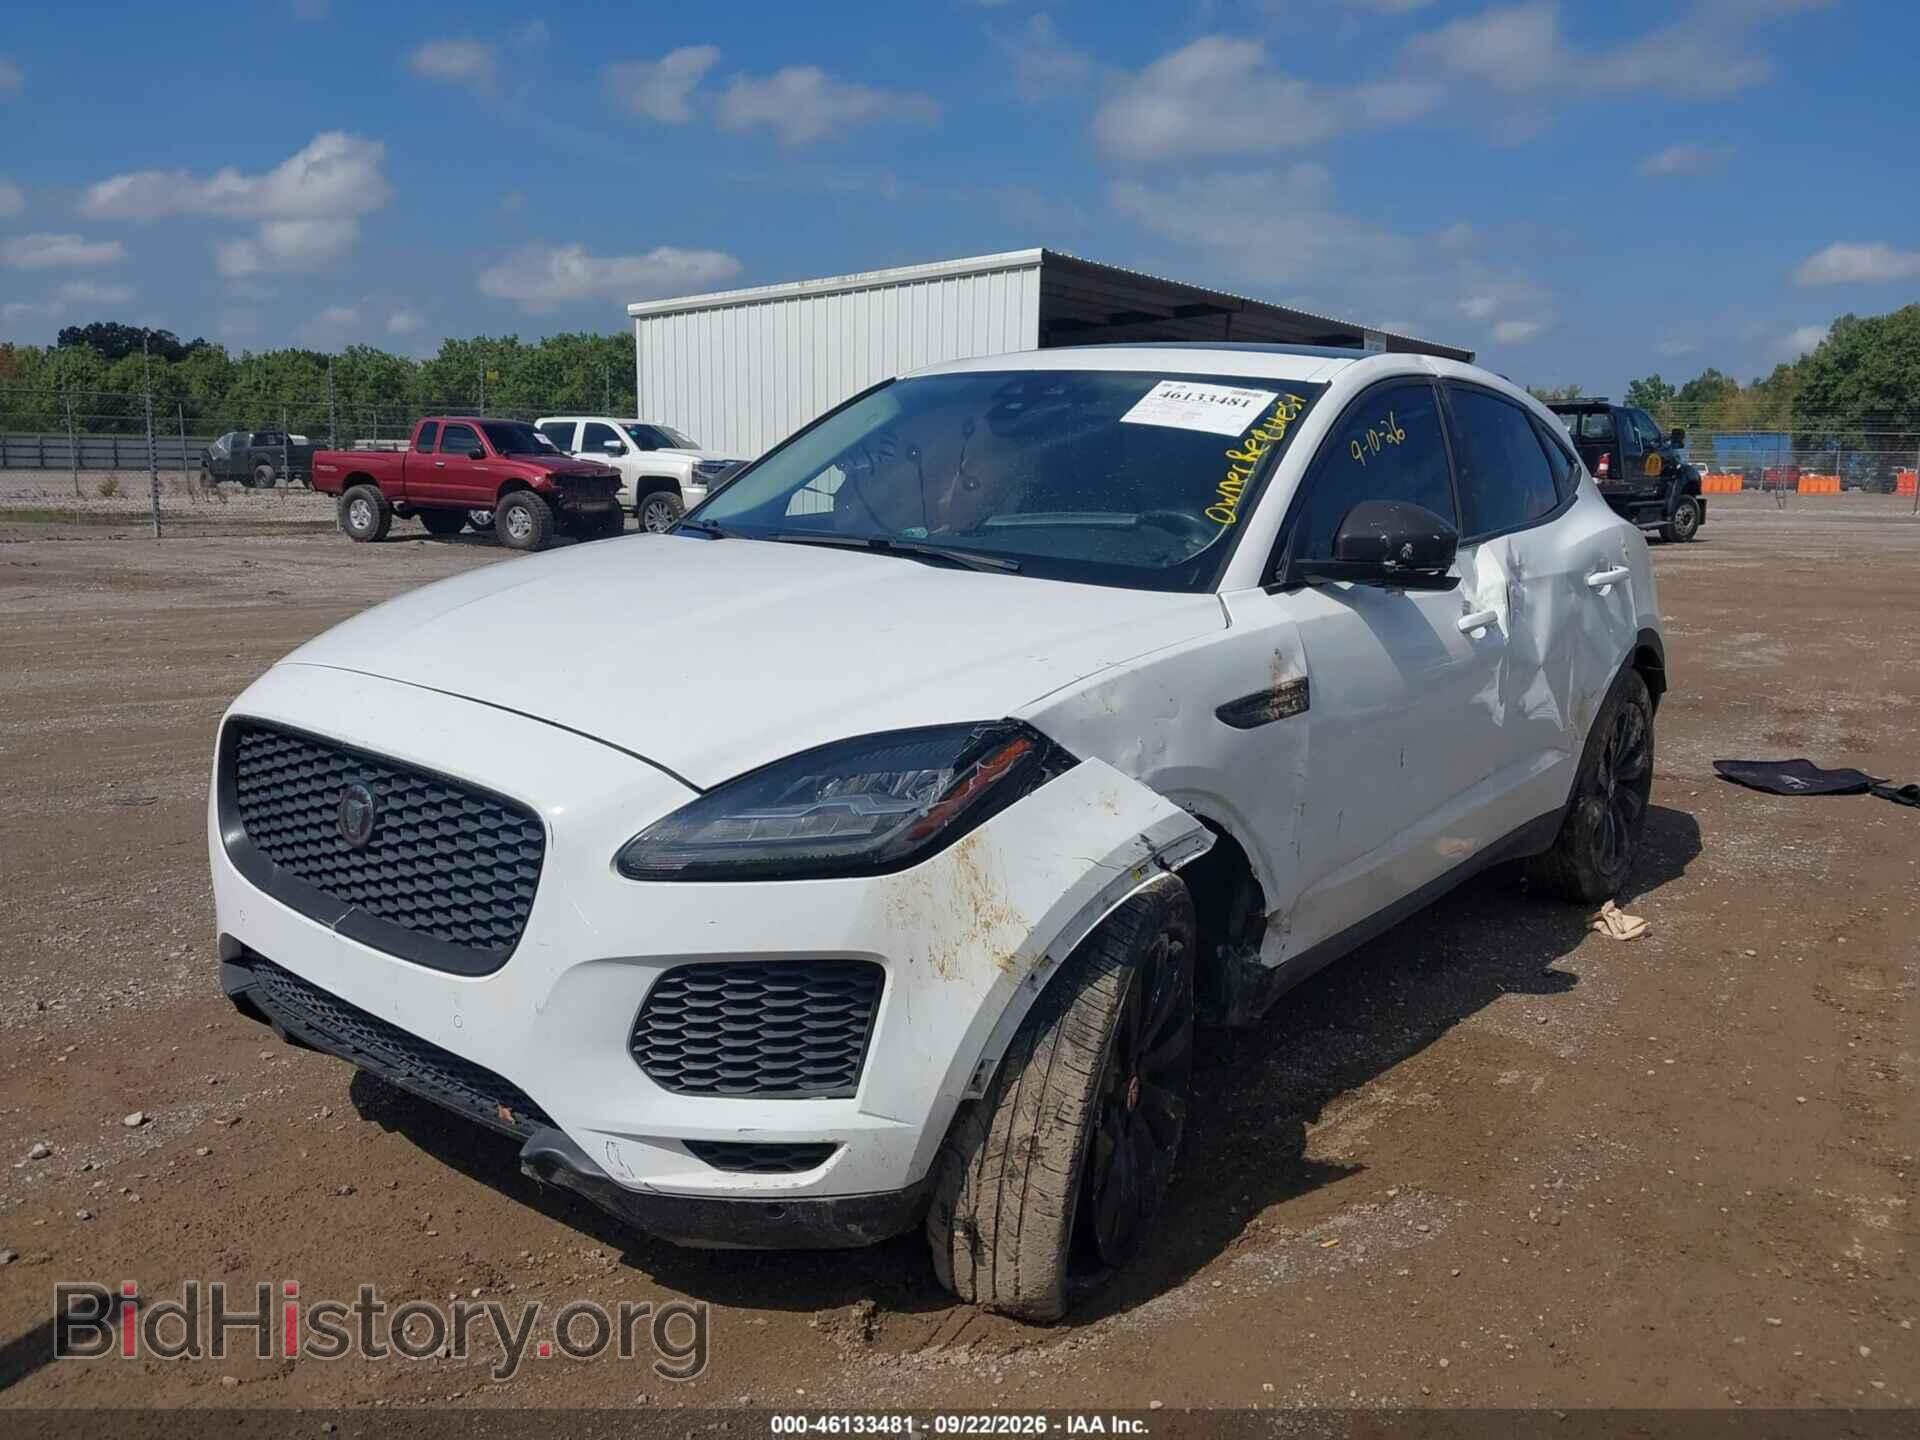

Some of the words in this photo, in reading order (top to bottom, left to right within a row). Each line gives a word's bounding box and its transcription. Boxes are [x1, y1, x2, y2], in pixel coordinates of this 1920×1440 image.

[1158, 390, 1252, 409] 46133481
[1351, 411, 1406, 467] 9-10-26
[1204, 463, 1255, 524] Owner
